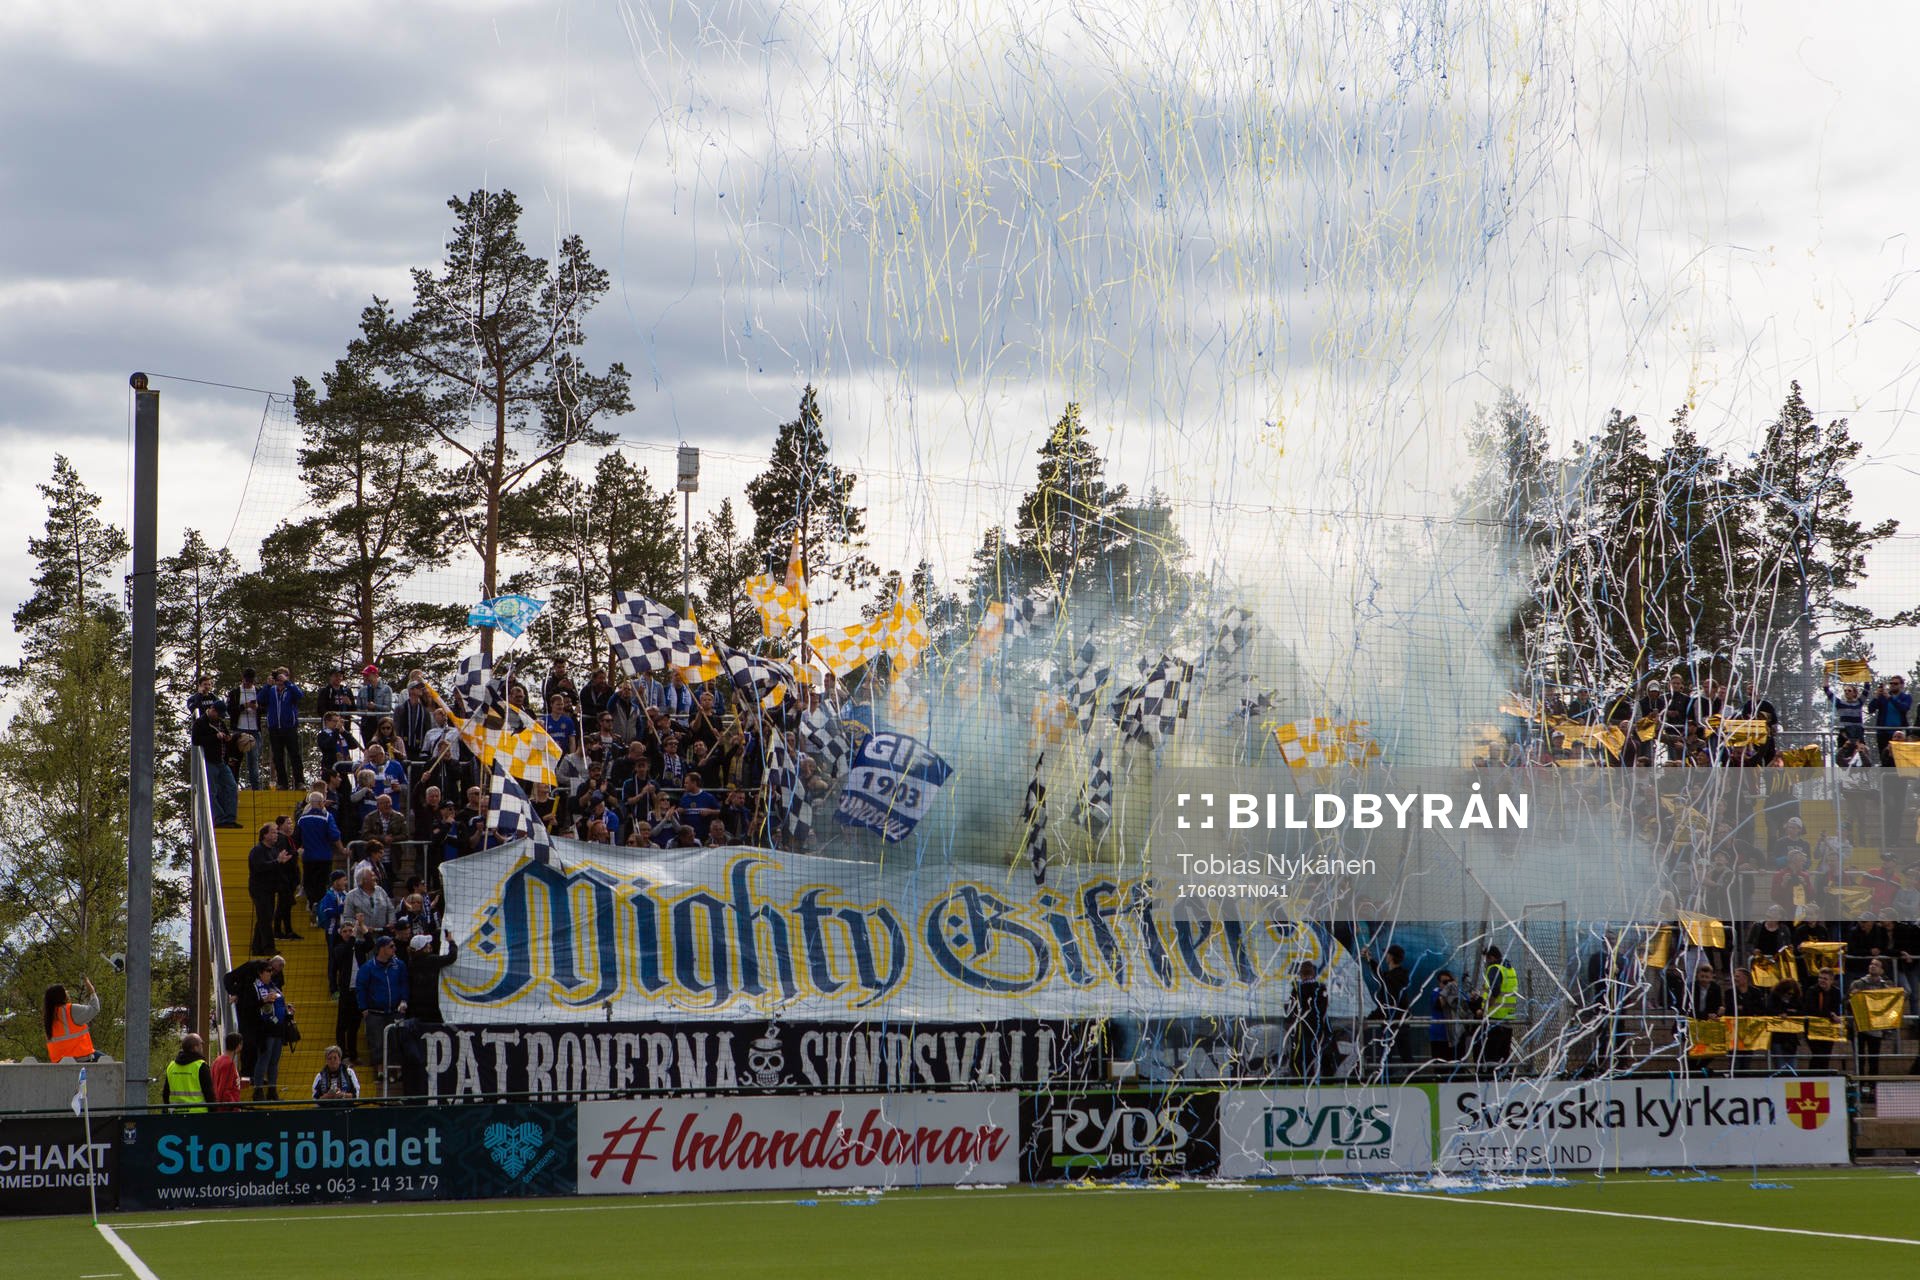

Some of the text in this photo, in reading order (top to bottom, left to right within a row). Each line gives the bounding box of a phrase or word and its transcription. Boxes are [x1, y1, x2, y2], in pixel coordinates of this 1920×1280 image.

[864, 733, 938, 773] GIF
[862, 771, 921, 808] 1903
[445, 854, 912, 1011] Mighty
[421, 1028, 738, 1106] PATRONERNA
[1051, 1107, 1189, 1153] RYDS
[1263, 1104, 1392, 1148] RYDS
[1456, 1086, 1776, 1138] Svenska kyrkan
[0, 1143, 112, 1172] CHAKT
[157, 1128, 442, 1179] Storsjöbadet
[1111, 1152, 1187, 1167] BILGLAS
[1346, 1148, 1391, 1160] GLAS
[157, 1181, 311, 1200] www.storsjobadet.se
[326, 1178, 356, 1194] 063
[371, 1176, 391, 1192] 14
[396, 1175, 414, 1191] 31
[419, 1175, 439, 1191] 79
